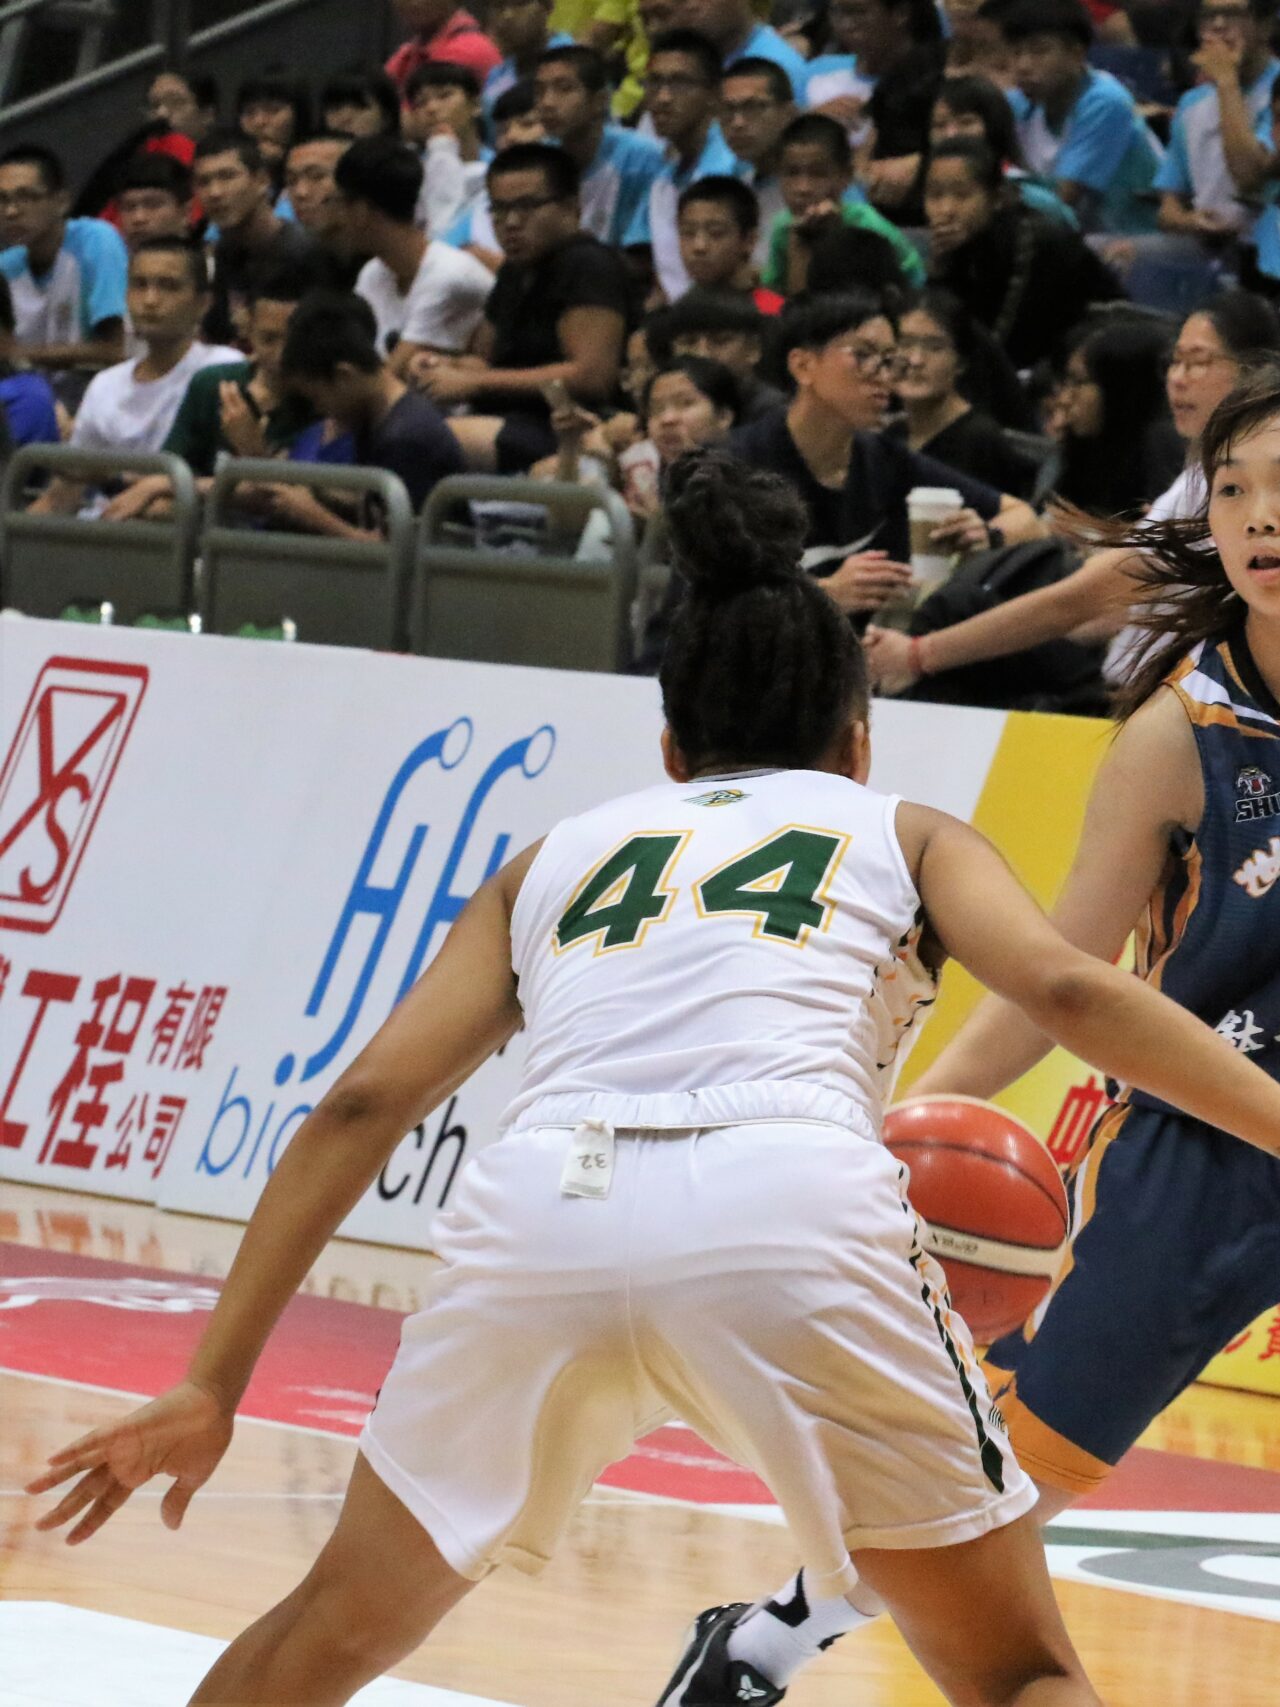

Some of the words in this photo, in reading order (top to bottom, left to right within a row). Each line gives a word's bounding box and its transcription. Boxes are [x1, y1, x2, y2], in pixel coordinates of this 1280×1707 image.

[551, 823, 852, 957] 44
[0, 955, 157, 1170] 工程
[104, 1092, 188, 1180] 公司
[196, 1064, 467, 1209] bioch
